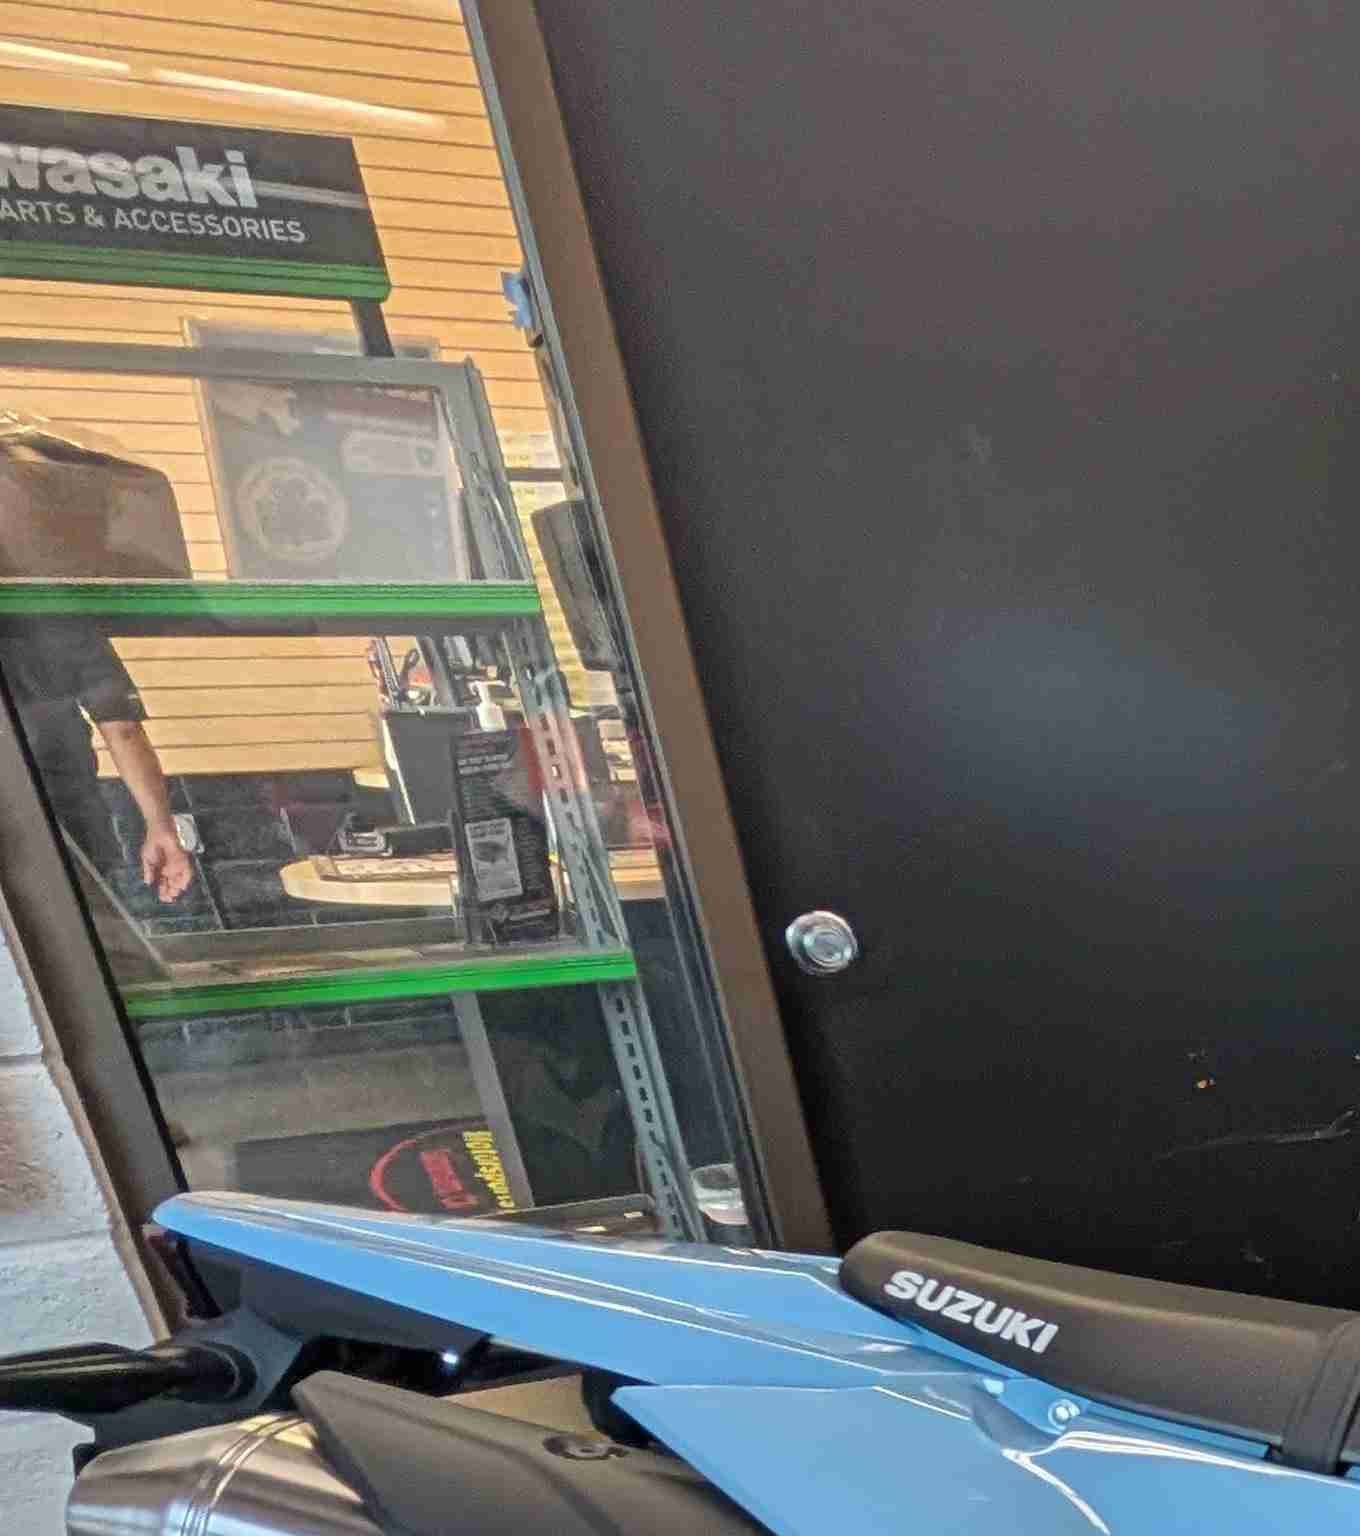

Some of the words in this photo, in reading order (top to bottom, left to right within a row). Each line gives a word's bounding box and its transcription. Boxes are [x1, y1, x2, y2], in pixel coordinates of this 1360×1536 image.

[84, 205, 104, 228] &
[114, 208, 306, 243] ACCESSORIES
[884, 1270, 1059, 1354] SUZUKI
